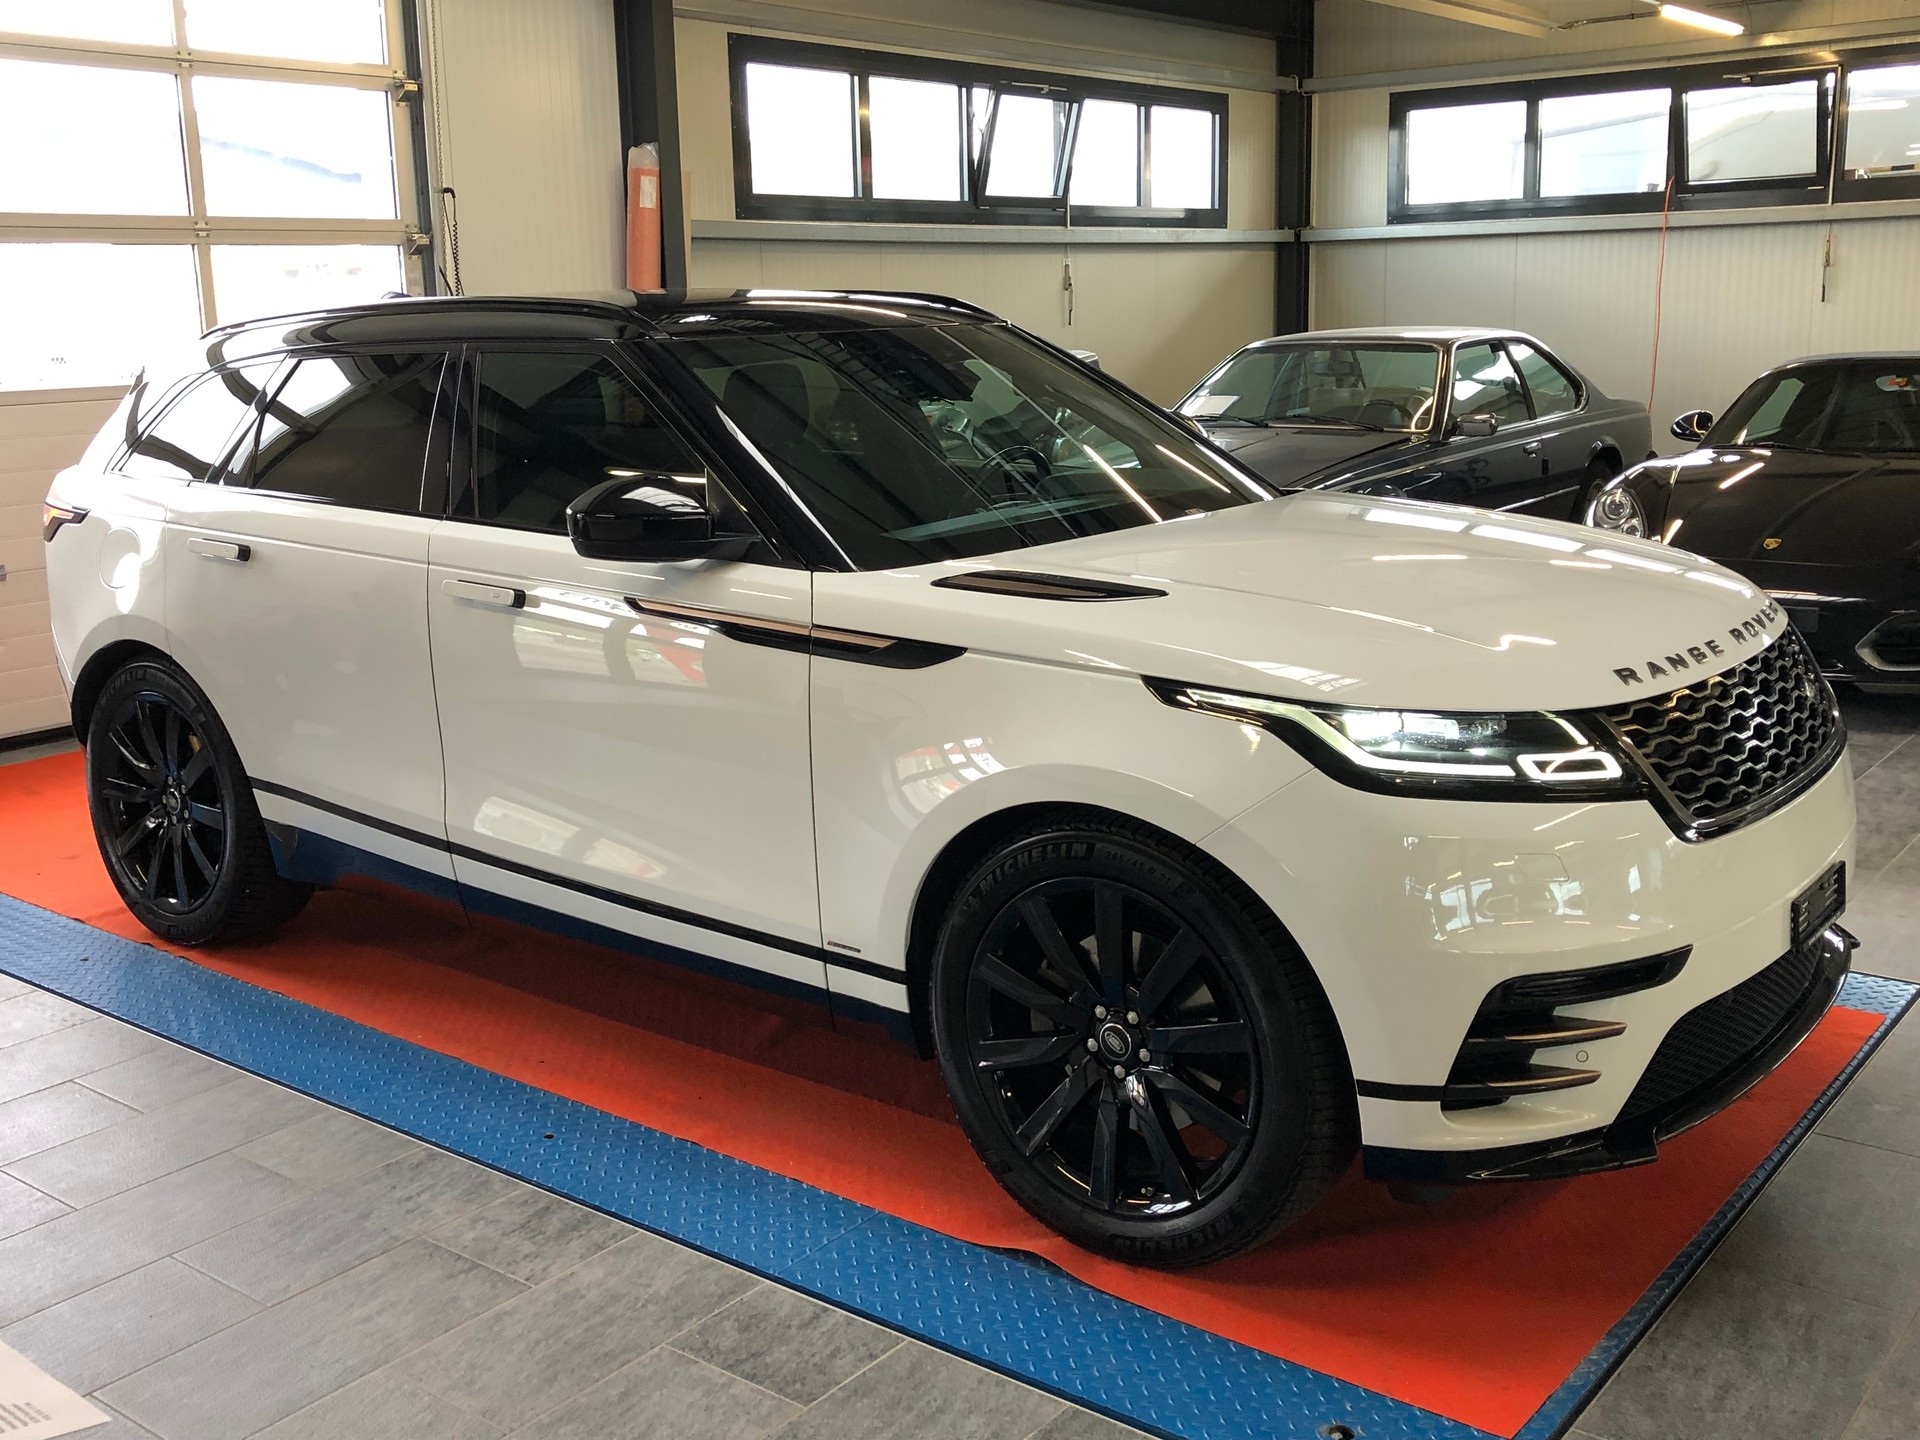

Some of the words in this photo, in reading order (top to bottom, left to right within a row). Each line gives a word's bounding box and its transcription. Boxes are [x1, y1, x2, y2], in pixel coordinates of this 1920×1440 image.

[1613, 639, 1725, 686] RANGE
[1728, 602, 1780, 645] ROVER
[978, 842, 1088, 896] MICHELIN
